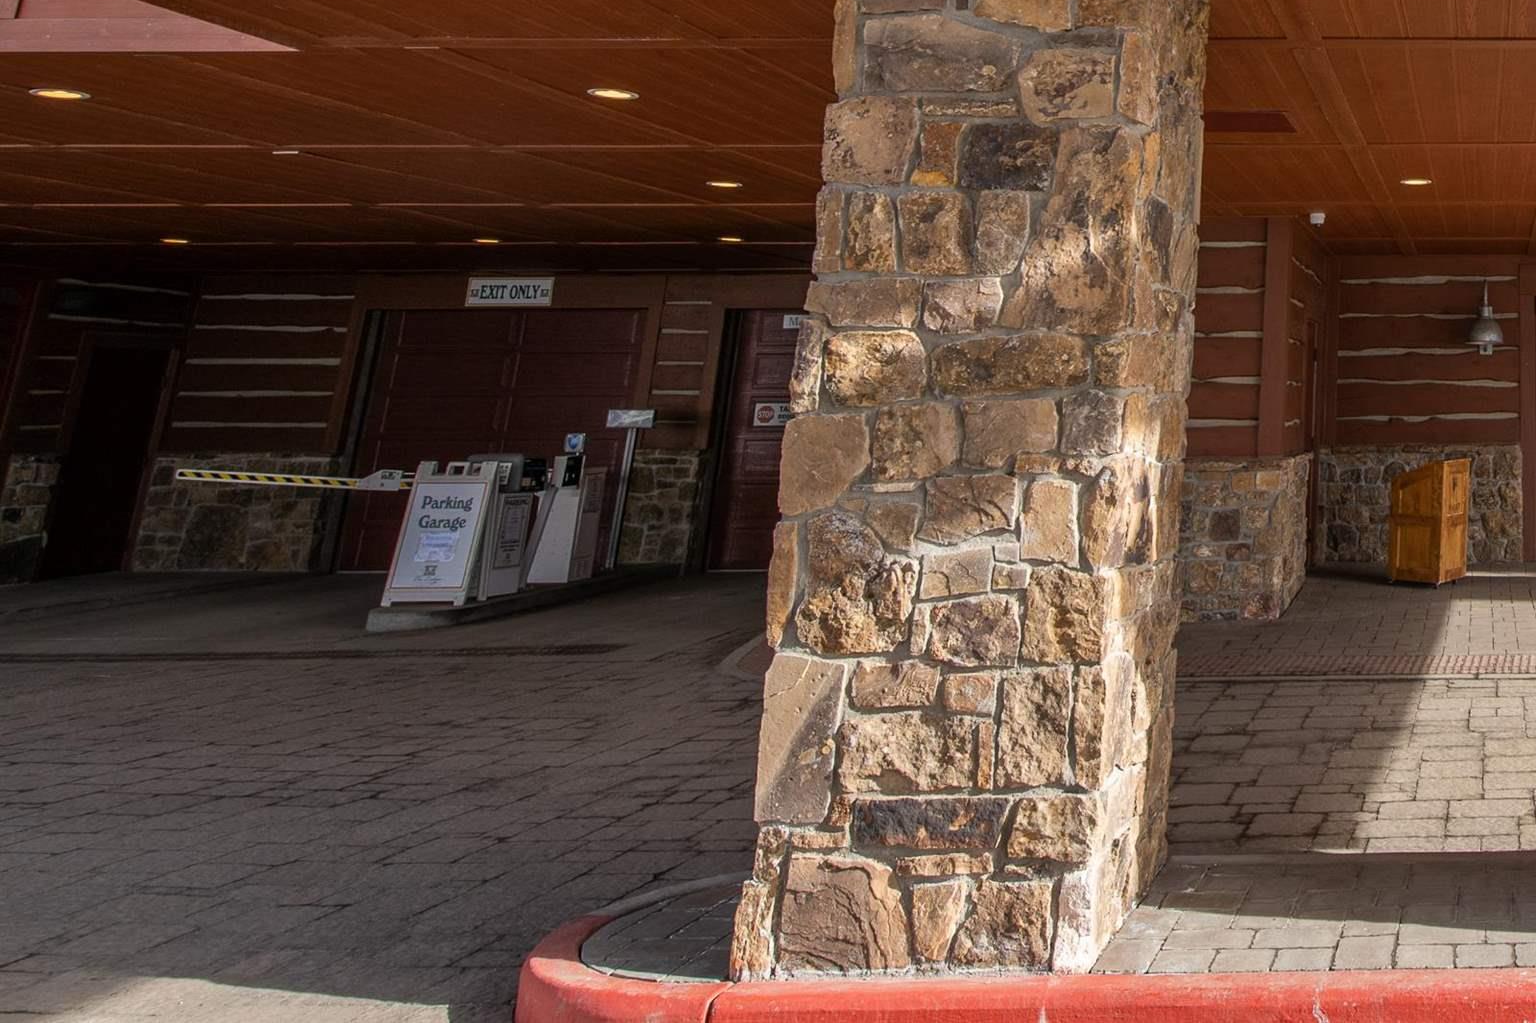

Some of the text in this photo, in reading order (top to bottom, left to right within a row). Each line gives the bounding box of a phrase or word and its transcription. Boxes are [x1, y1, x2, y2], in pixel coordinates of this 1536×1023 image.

[480, 284, 541, 300] EXIT ONLY
[421, 495, 474, 513] Parking
[418, 515, 467, 532] Garage
